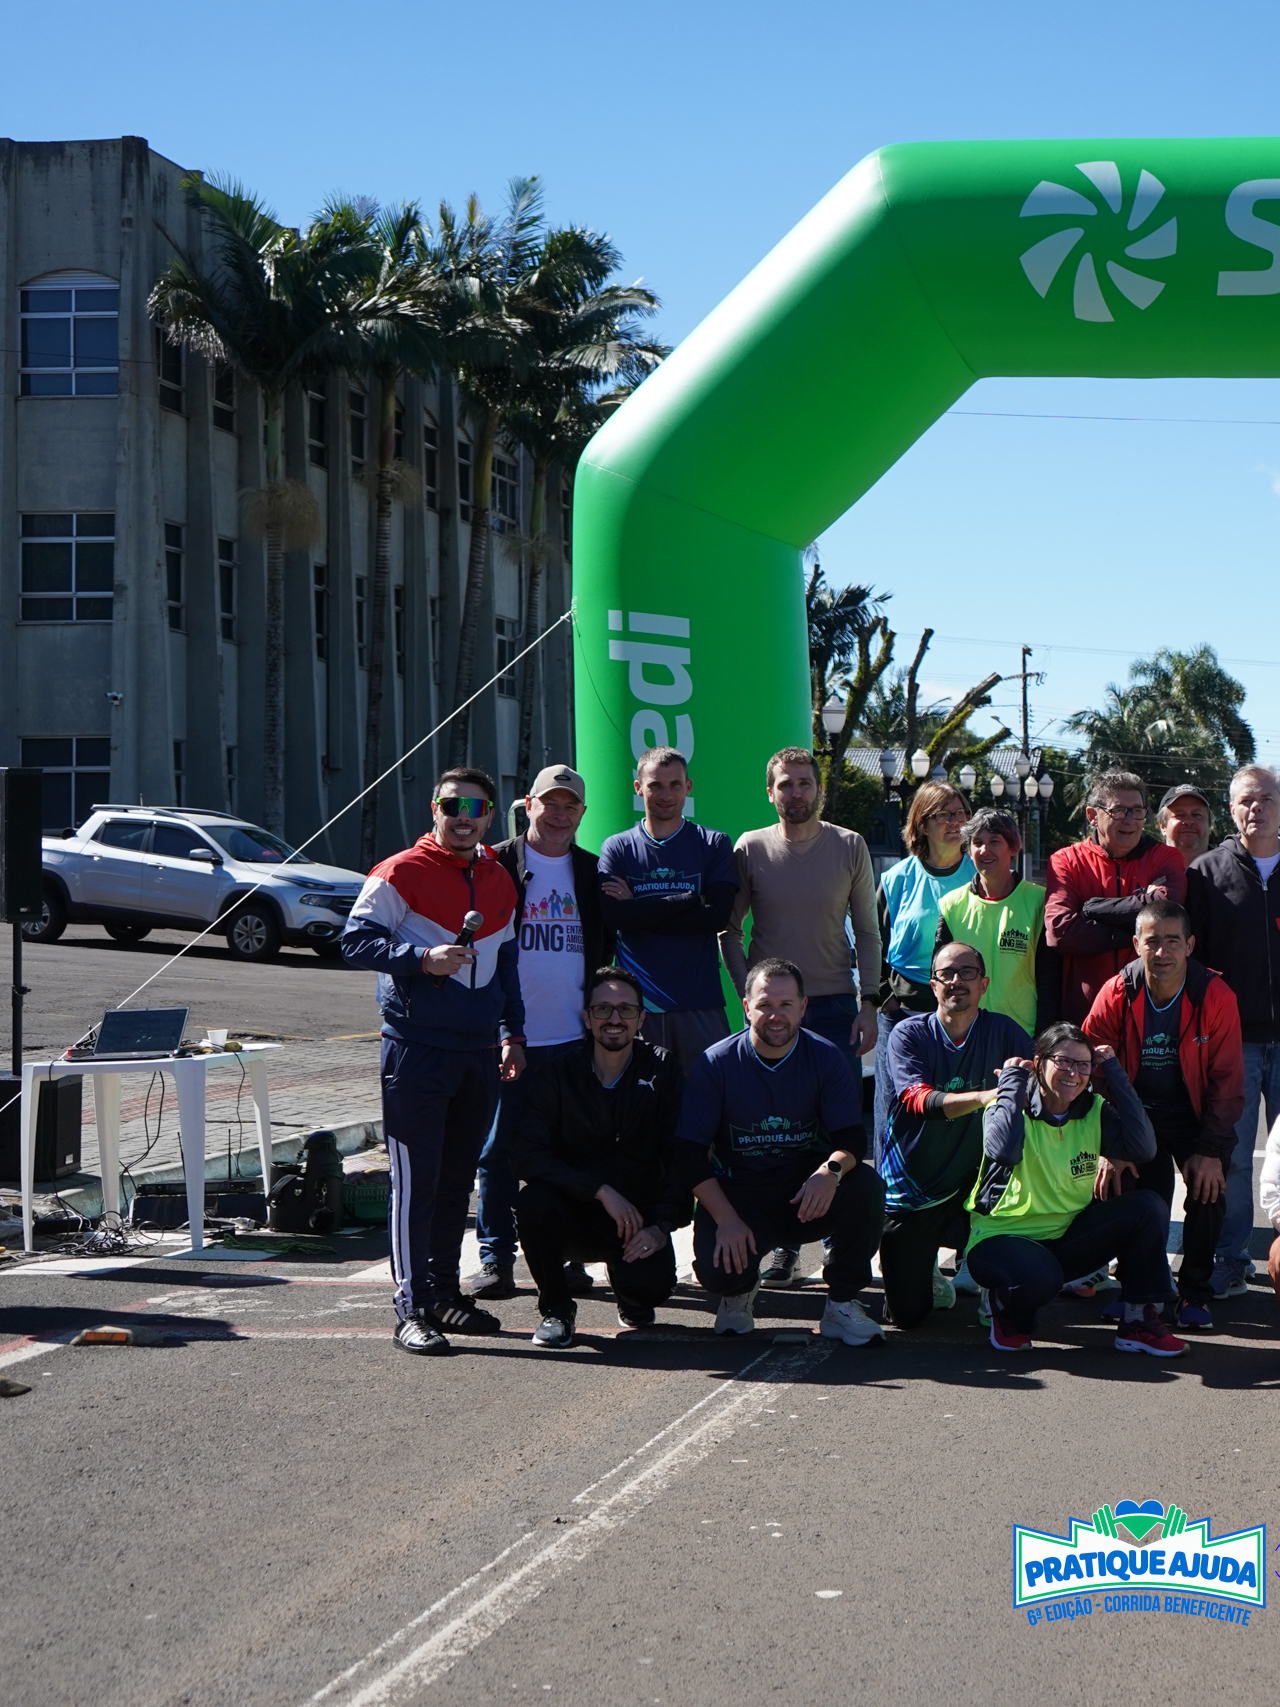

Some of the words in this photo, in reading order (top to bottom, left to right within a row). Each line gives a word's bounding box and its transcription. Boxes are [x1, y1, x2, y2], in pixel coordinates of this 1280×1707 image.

[633, 882, 669, 893] PRATIQUE
[670, 882, 695, 891] AJUDA
[521, 923, 564, 952] ONG
[1000, 938, 1015, 948] ONG
[738, 1133, 784, 1144] PRATIQUE
[784, 1132, 812, 1142] AJUDA
